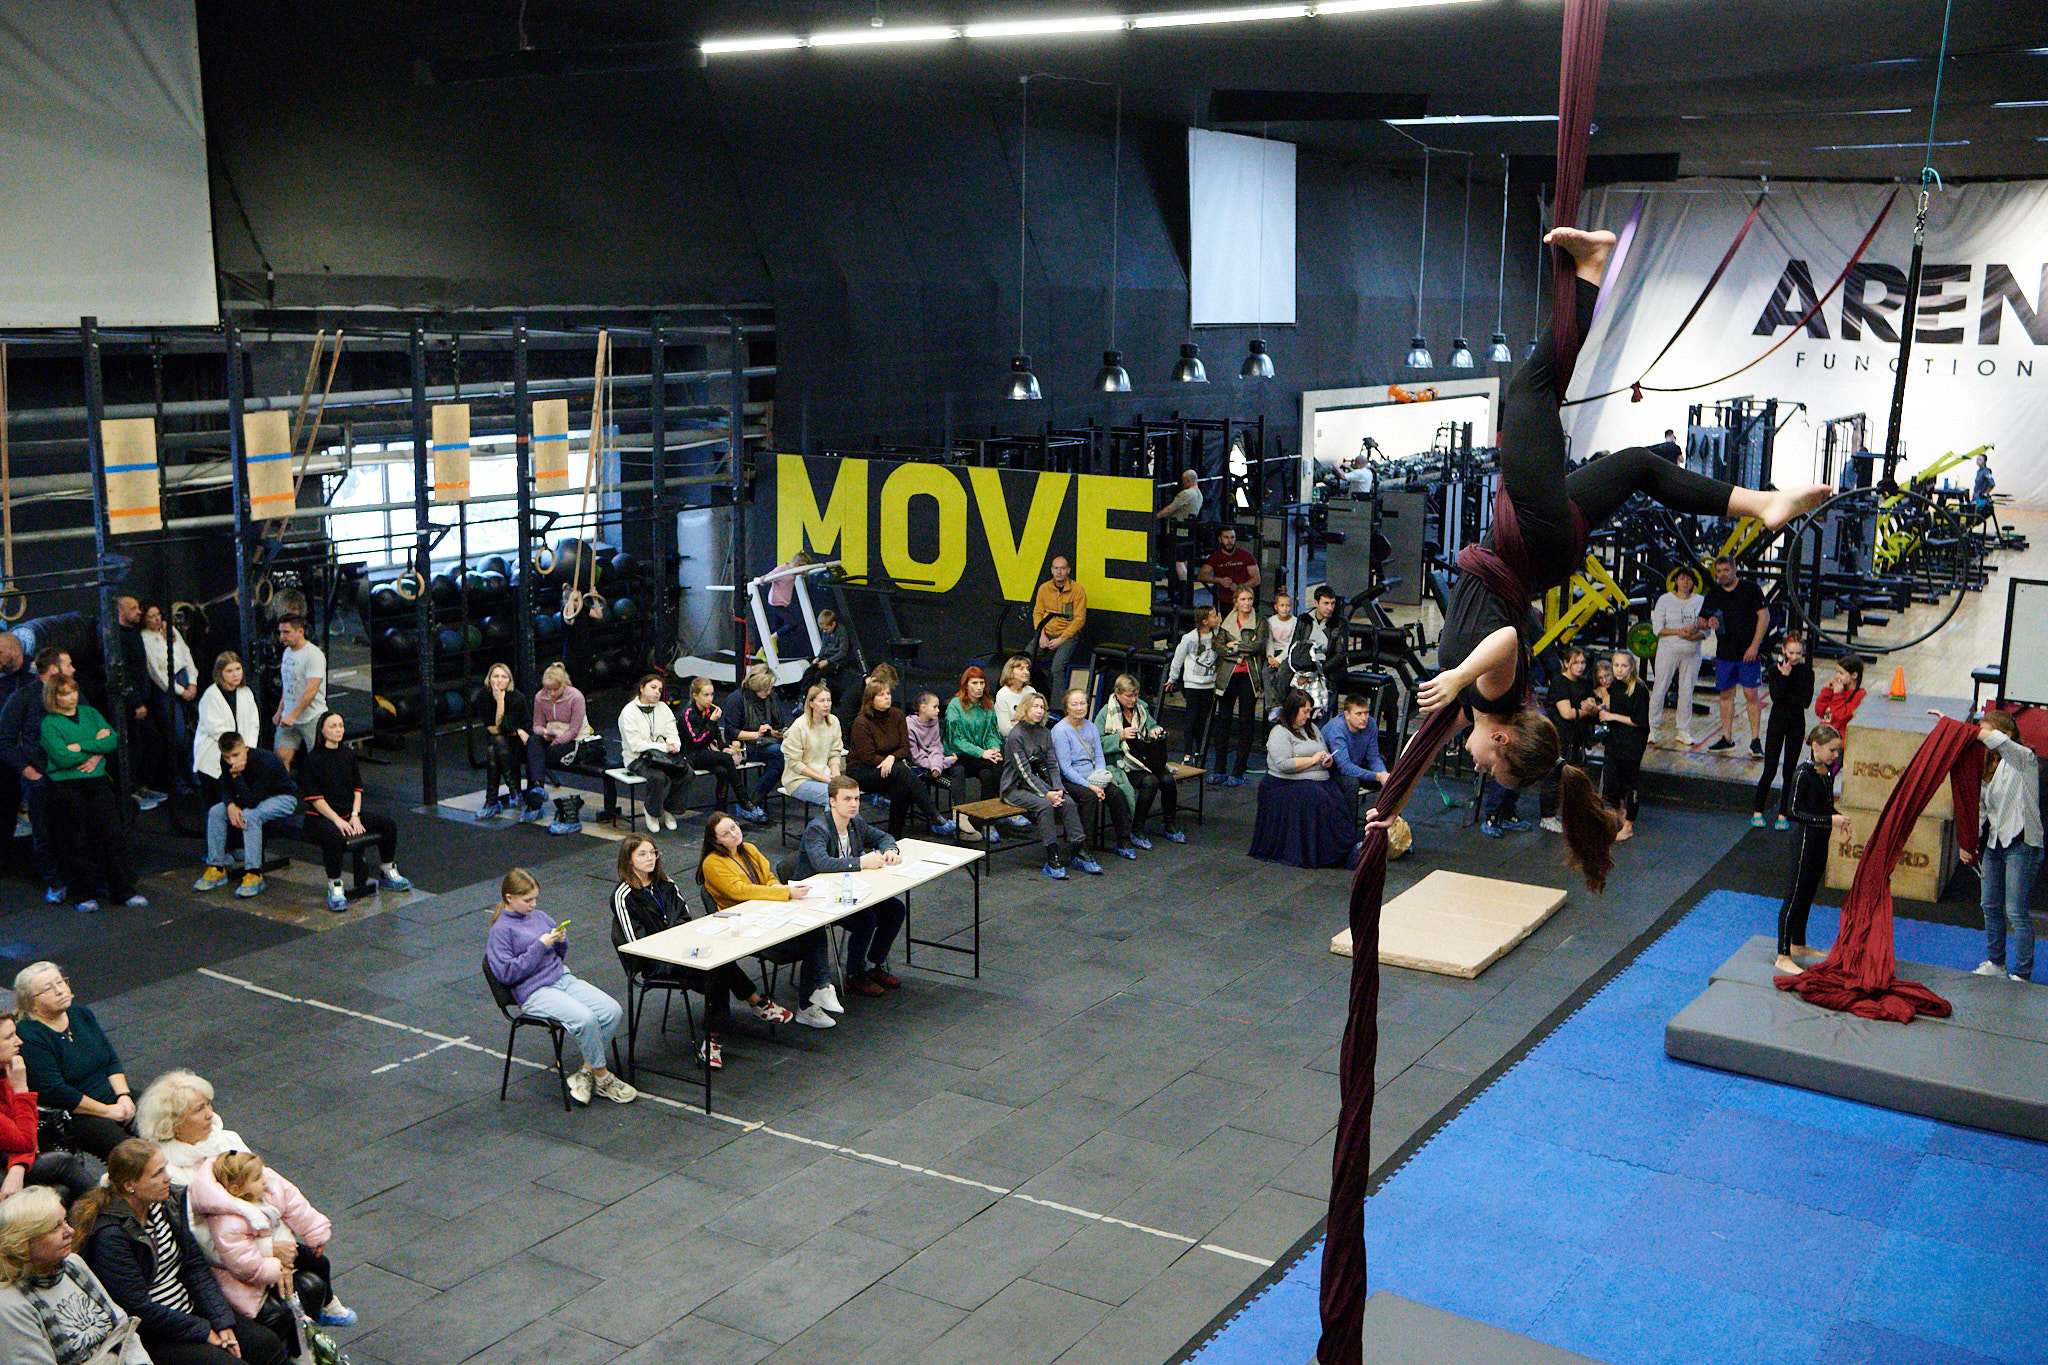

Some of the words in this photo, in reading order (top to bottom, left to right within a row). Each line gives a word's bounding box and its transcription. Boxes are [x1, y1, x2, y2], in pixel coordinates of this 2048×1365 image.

[1752, 259, 2048, 346] AREN
[1796, 352, 2034, 377] FUNCTION
[777, 453, 1154, 616] MOVE
